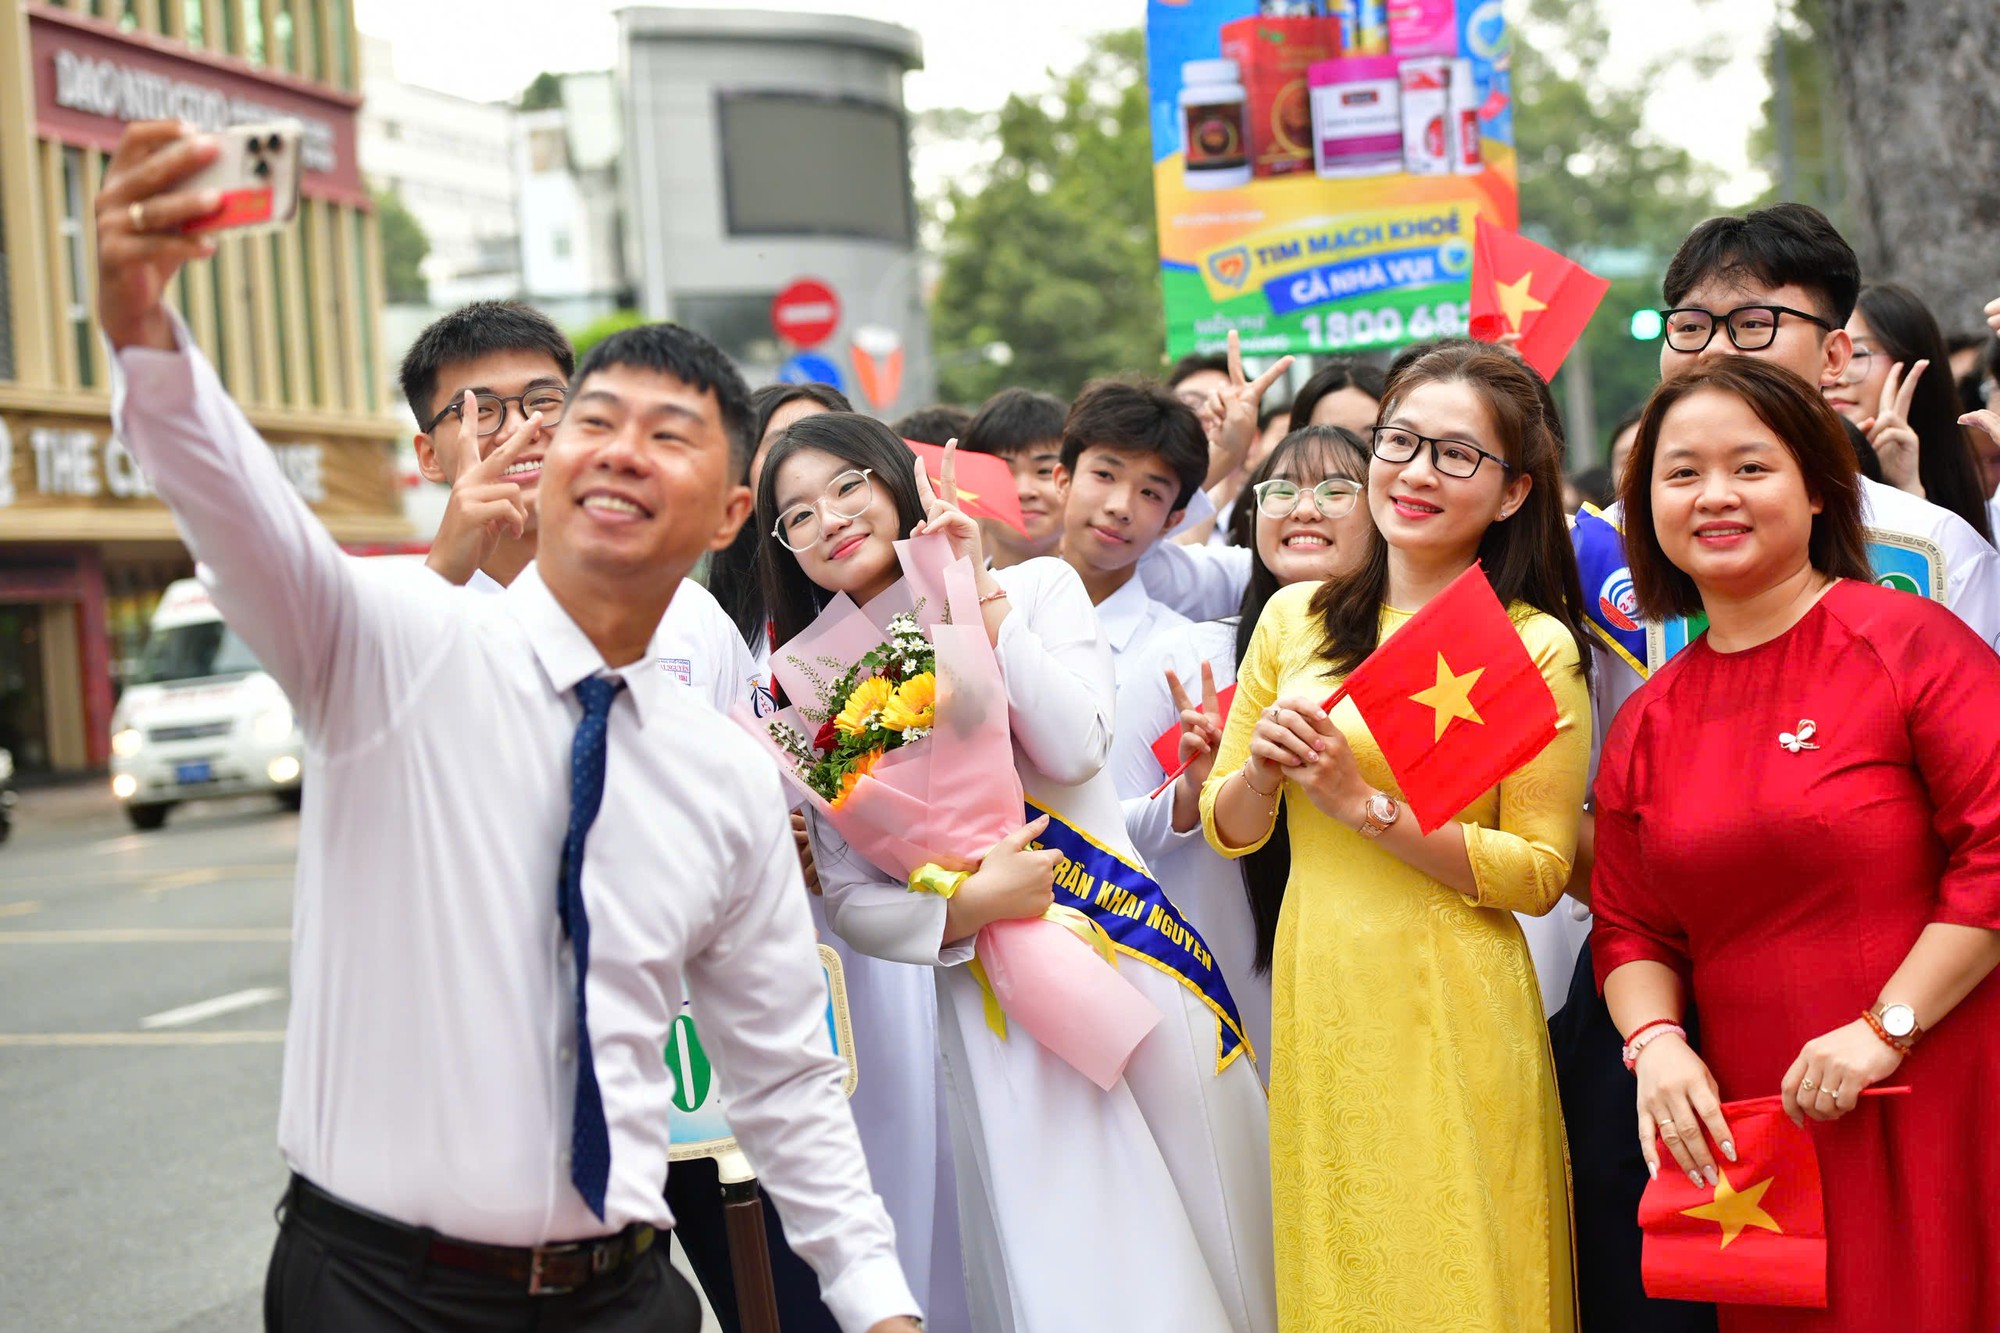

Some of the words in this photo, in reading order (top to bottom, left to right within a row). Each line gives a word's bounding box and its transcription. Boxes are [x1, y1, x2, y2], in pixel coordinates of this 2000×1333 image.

[1256, 241, 1302, 266] TIM
[1386, 257, 1434, 282] VUI
[1302, 307, 1403, 348] 1800
[31, 428, 98, 496] THE
[1054, 857, 1095, 900] RẦN
[1095, 880, 1146, 921] KHAI
